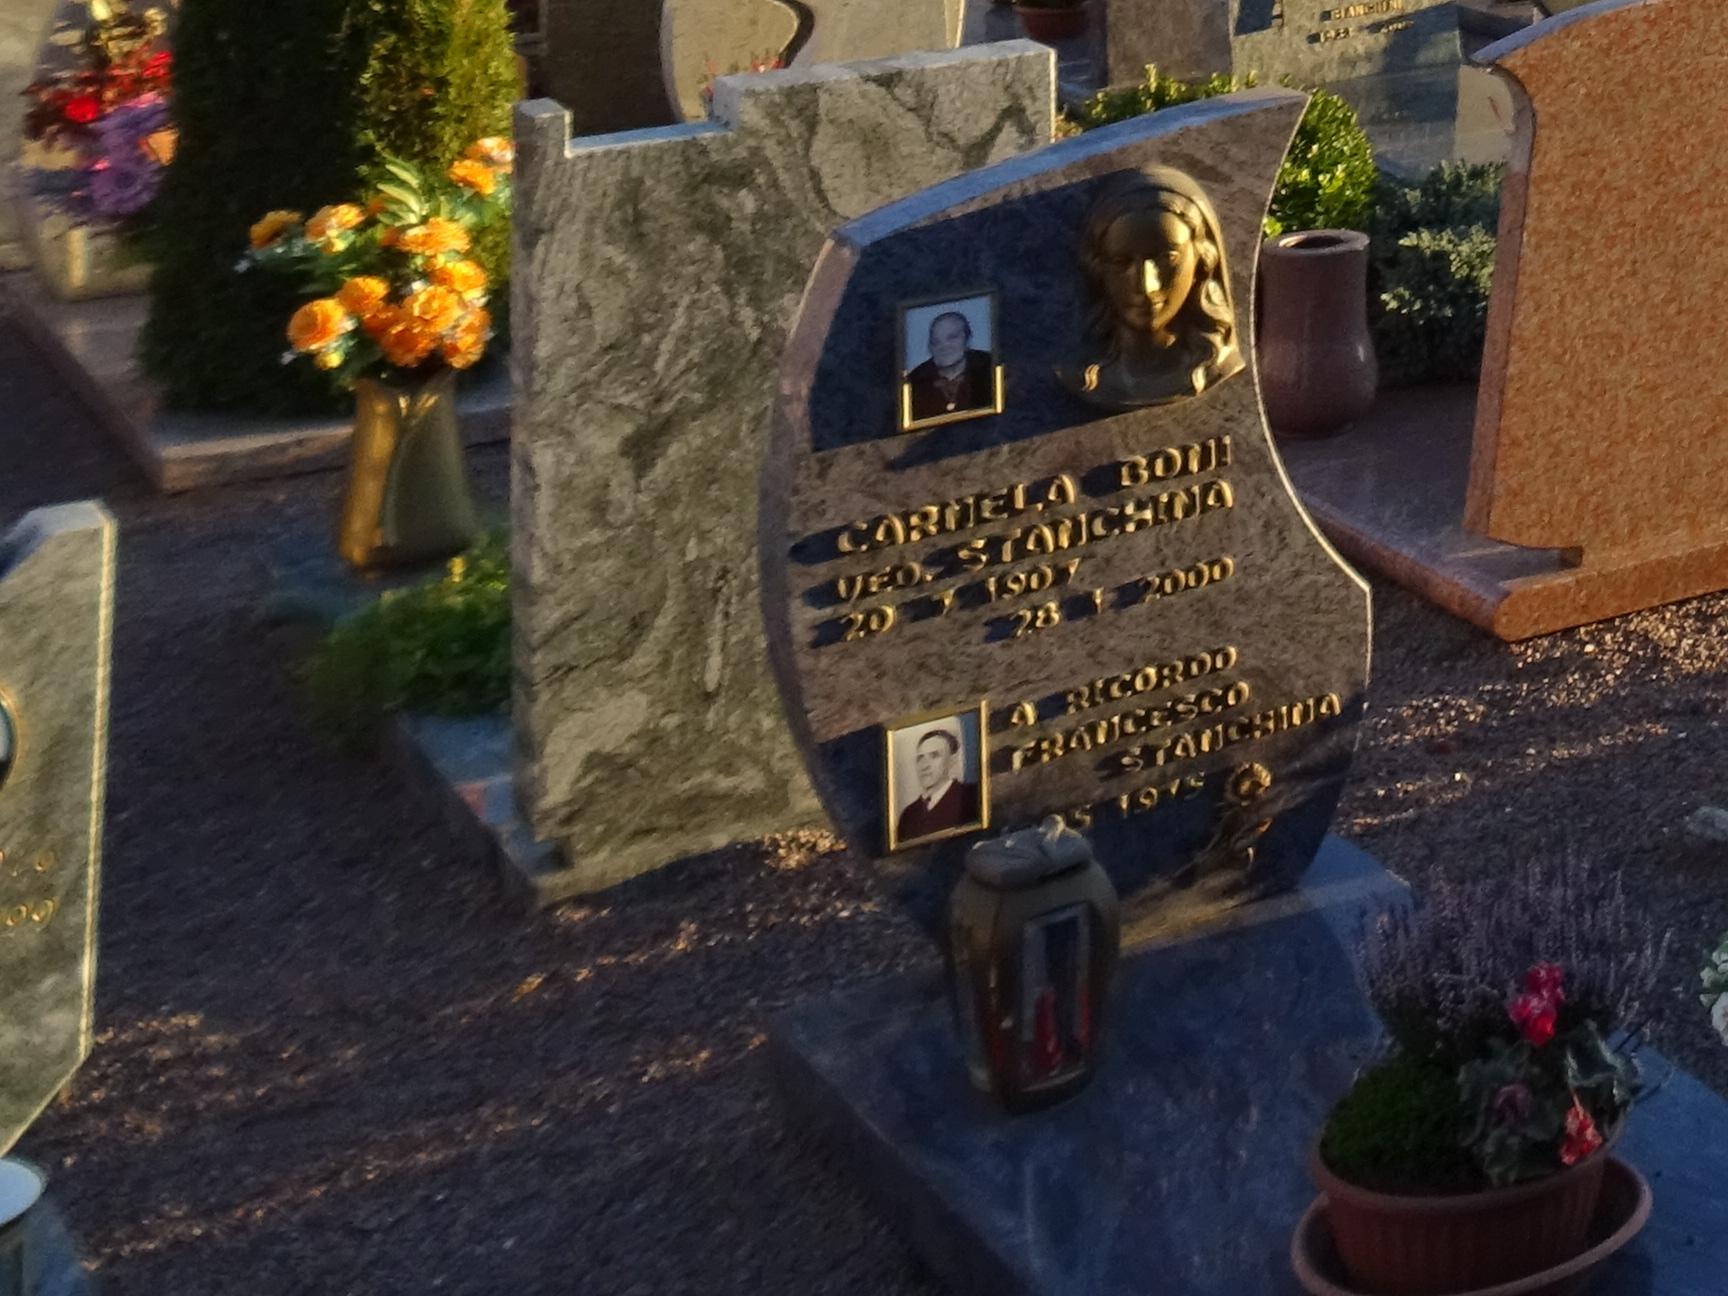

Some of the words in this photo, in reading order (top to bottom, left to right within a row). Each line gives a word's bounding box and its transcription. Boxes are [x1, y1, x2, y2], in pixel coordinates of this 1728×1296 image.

[837, 472, 1078, 554] CARMELA
[1120, 434, 1233, 489] BONI
[956, 477, 1234, 572] STANCHINA
[845, 603, 897, 643] 20
[986, 557, 1083, 603] 1907
[1013, 600, 1062, 639] 28
[1143, 555, 1236, 606] 2000
[1011, 700, 1037, 727] A
[1066, 645, 1238, 715] RICORDO
[1011, 680, 1251, 775] FRANCESCO
[1120, 692, 1342, 773] STANCHINA
